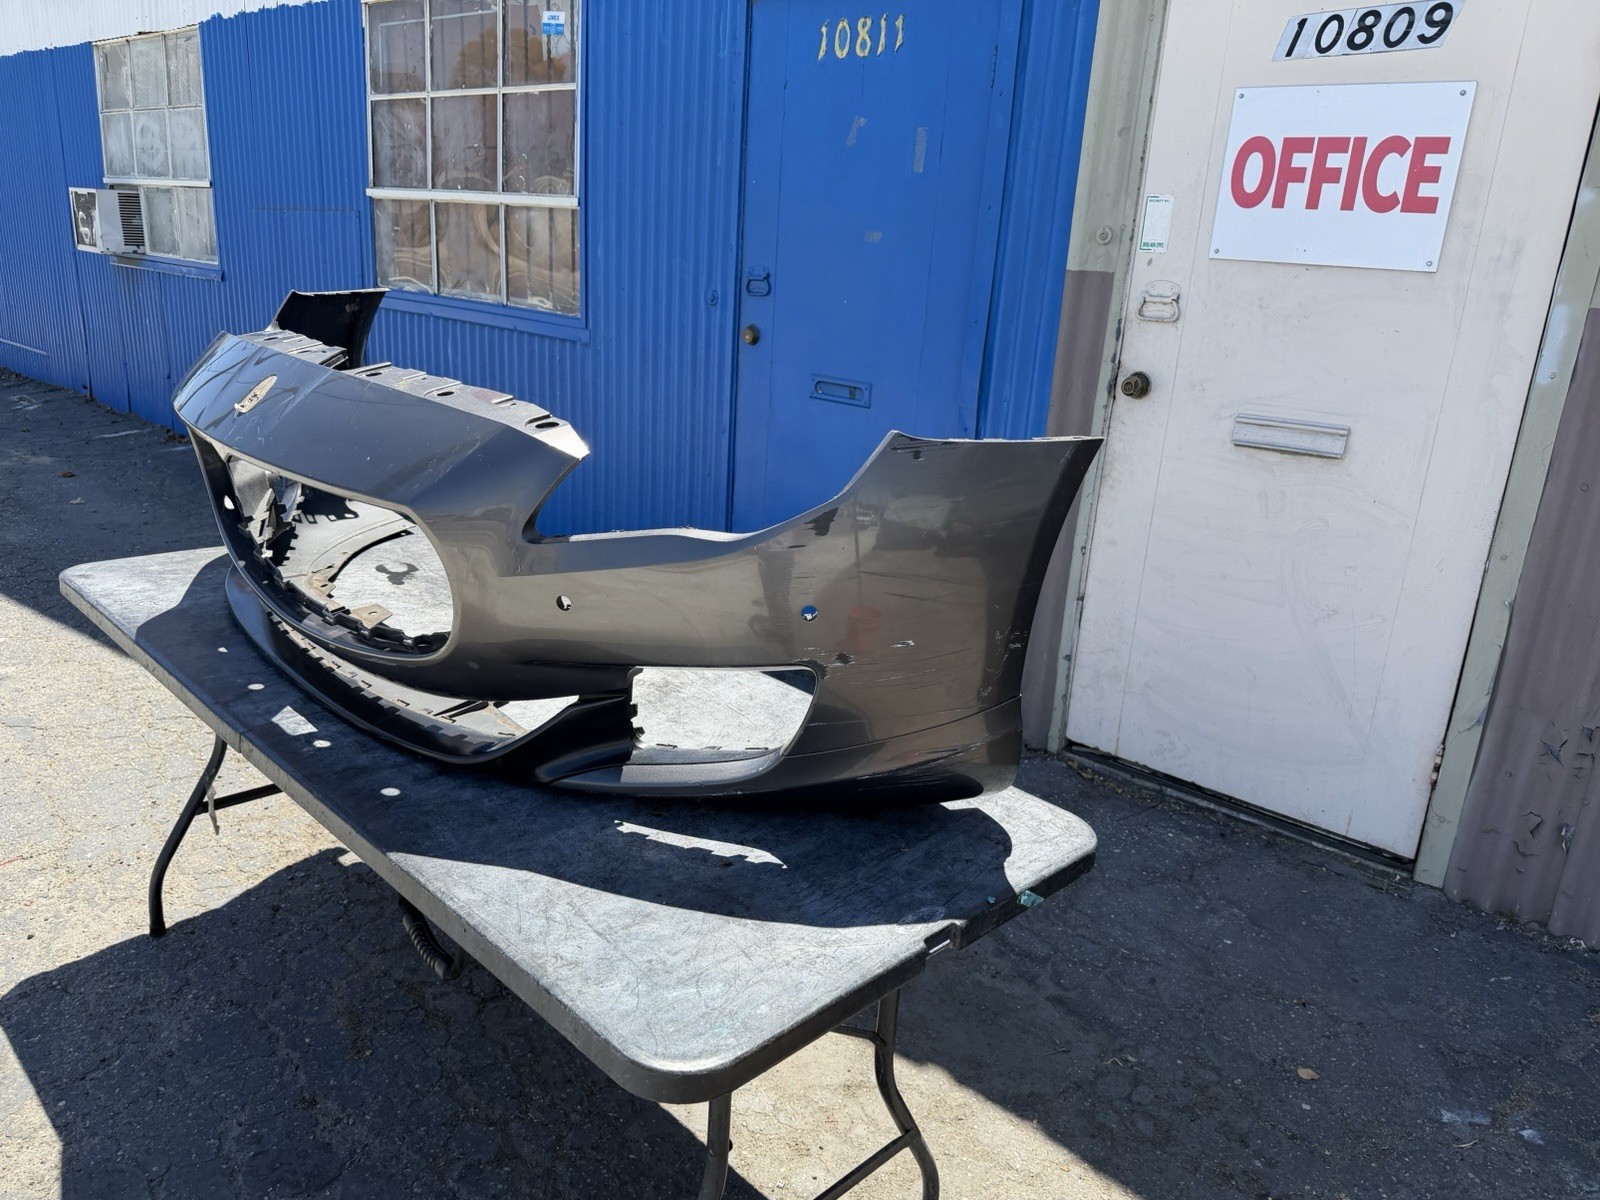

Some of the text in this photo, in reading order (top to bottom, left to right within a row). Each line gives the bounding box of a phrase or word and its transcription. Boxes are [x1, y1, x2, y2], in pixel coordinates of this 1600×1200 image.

[818, 13, 904, 61] 10811
[1285, 2, 1453, 57] 10809
[1231, 135, 1451, 214] OFFICE
